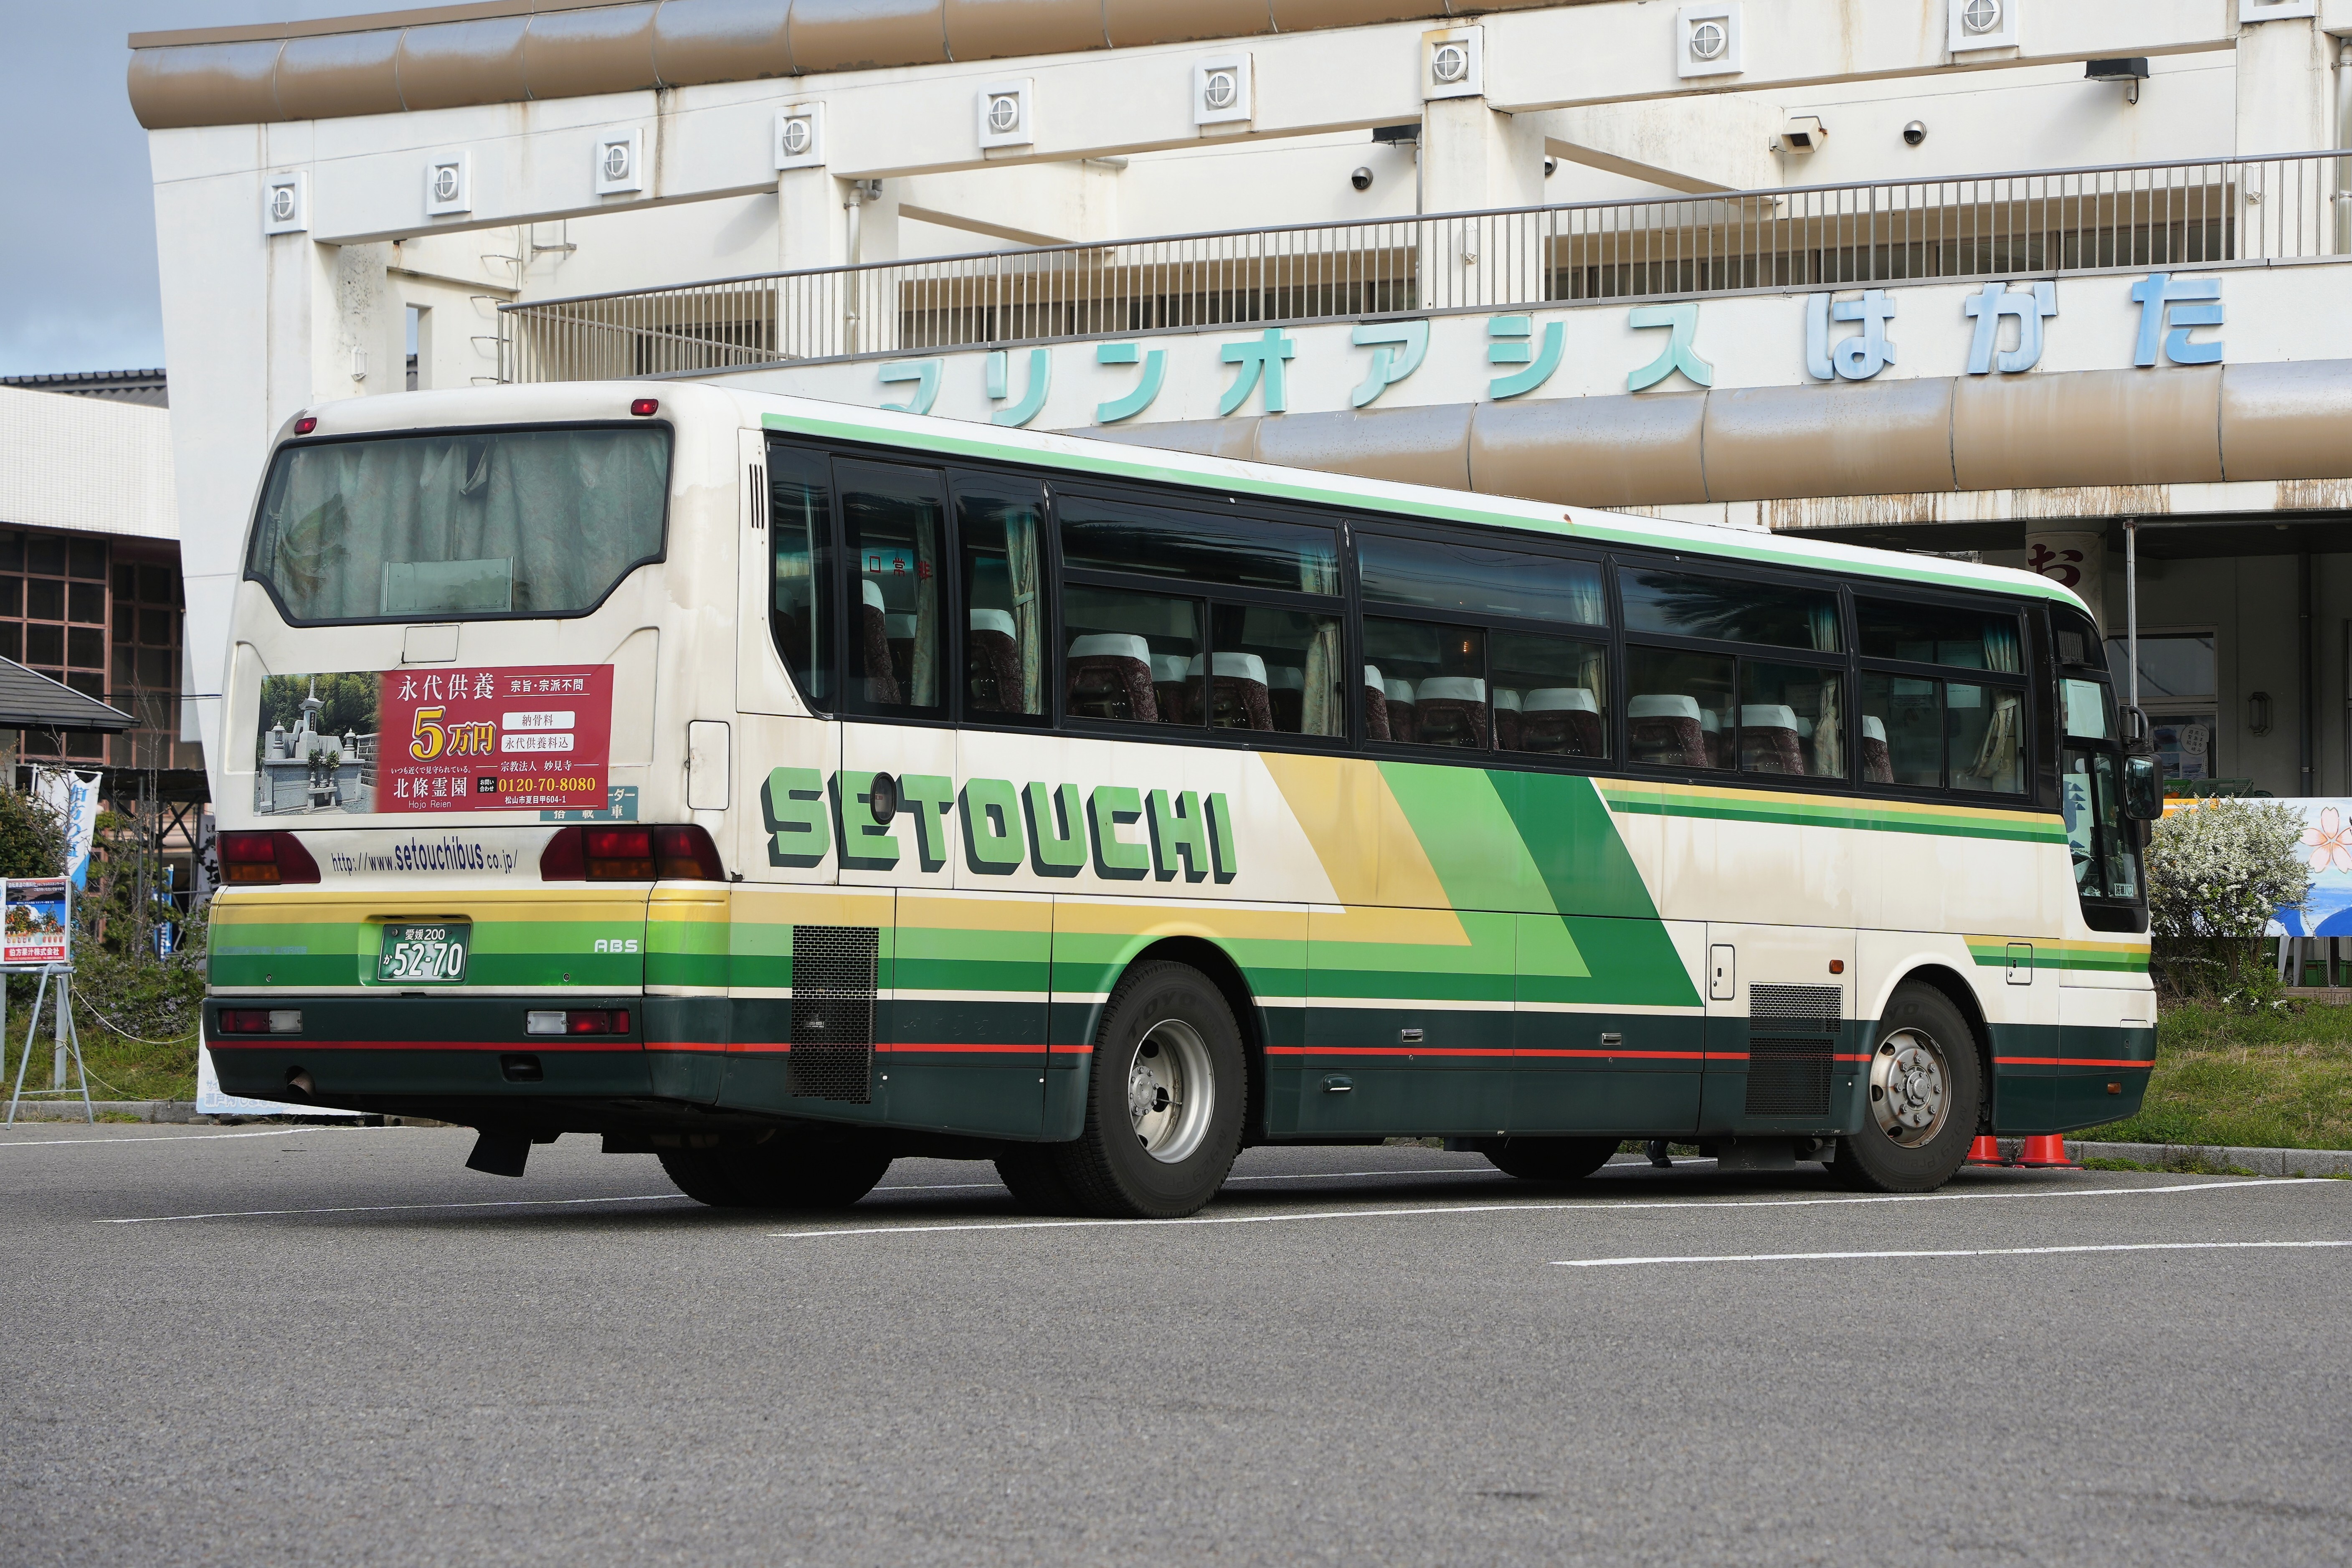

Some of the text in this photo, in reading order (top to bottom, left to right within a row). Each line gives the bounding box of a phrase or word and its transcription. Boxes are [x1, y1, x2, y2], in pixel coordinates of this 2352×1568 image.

[2028, 543, 2084, 588] お
[396, 673, 494, 702] 永代供養
[511, 678, 583, 693] 宗旨・宗派不問
[522, 714, 553, 727] 納骨料
[410, 705, 497, 762] 5万円
[504, 736, 569, 750] 永代供養料込
[391, 765, 473, 775] いつも近くで見守られている。
[501, 760, 572, 773] 宗教法人 妙見寺
[393, 776, 468, 798] 北條霊園
[499, 777, 596, 792] 0120-70-8080
[408, 799, 452, 809] Hojo Reien
[505, 795, 566, 804] 松山市夏目甲604-1
[760, 766, 1238, 885] SETOUCHI
[2115, 884, 2134, 895] 路線バス
[9, 947, 59, 957] 伯方果汁株式会社
[594, 939, 638, 953] ABS
[383, 954, 393, 965] か
